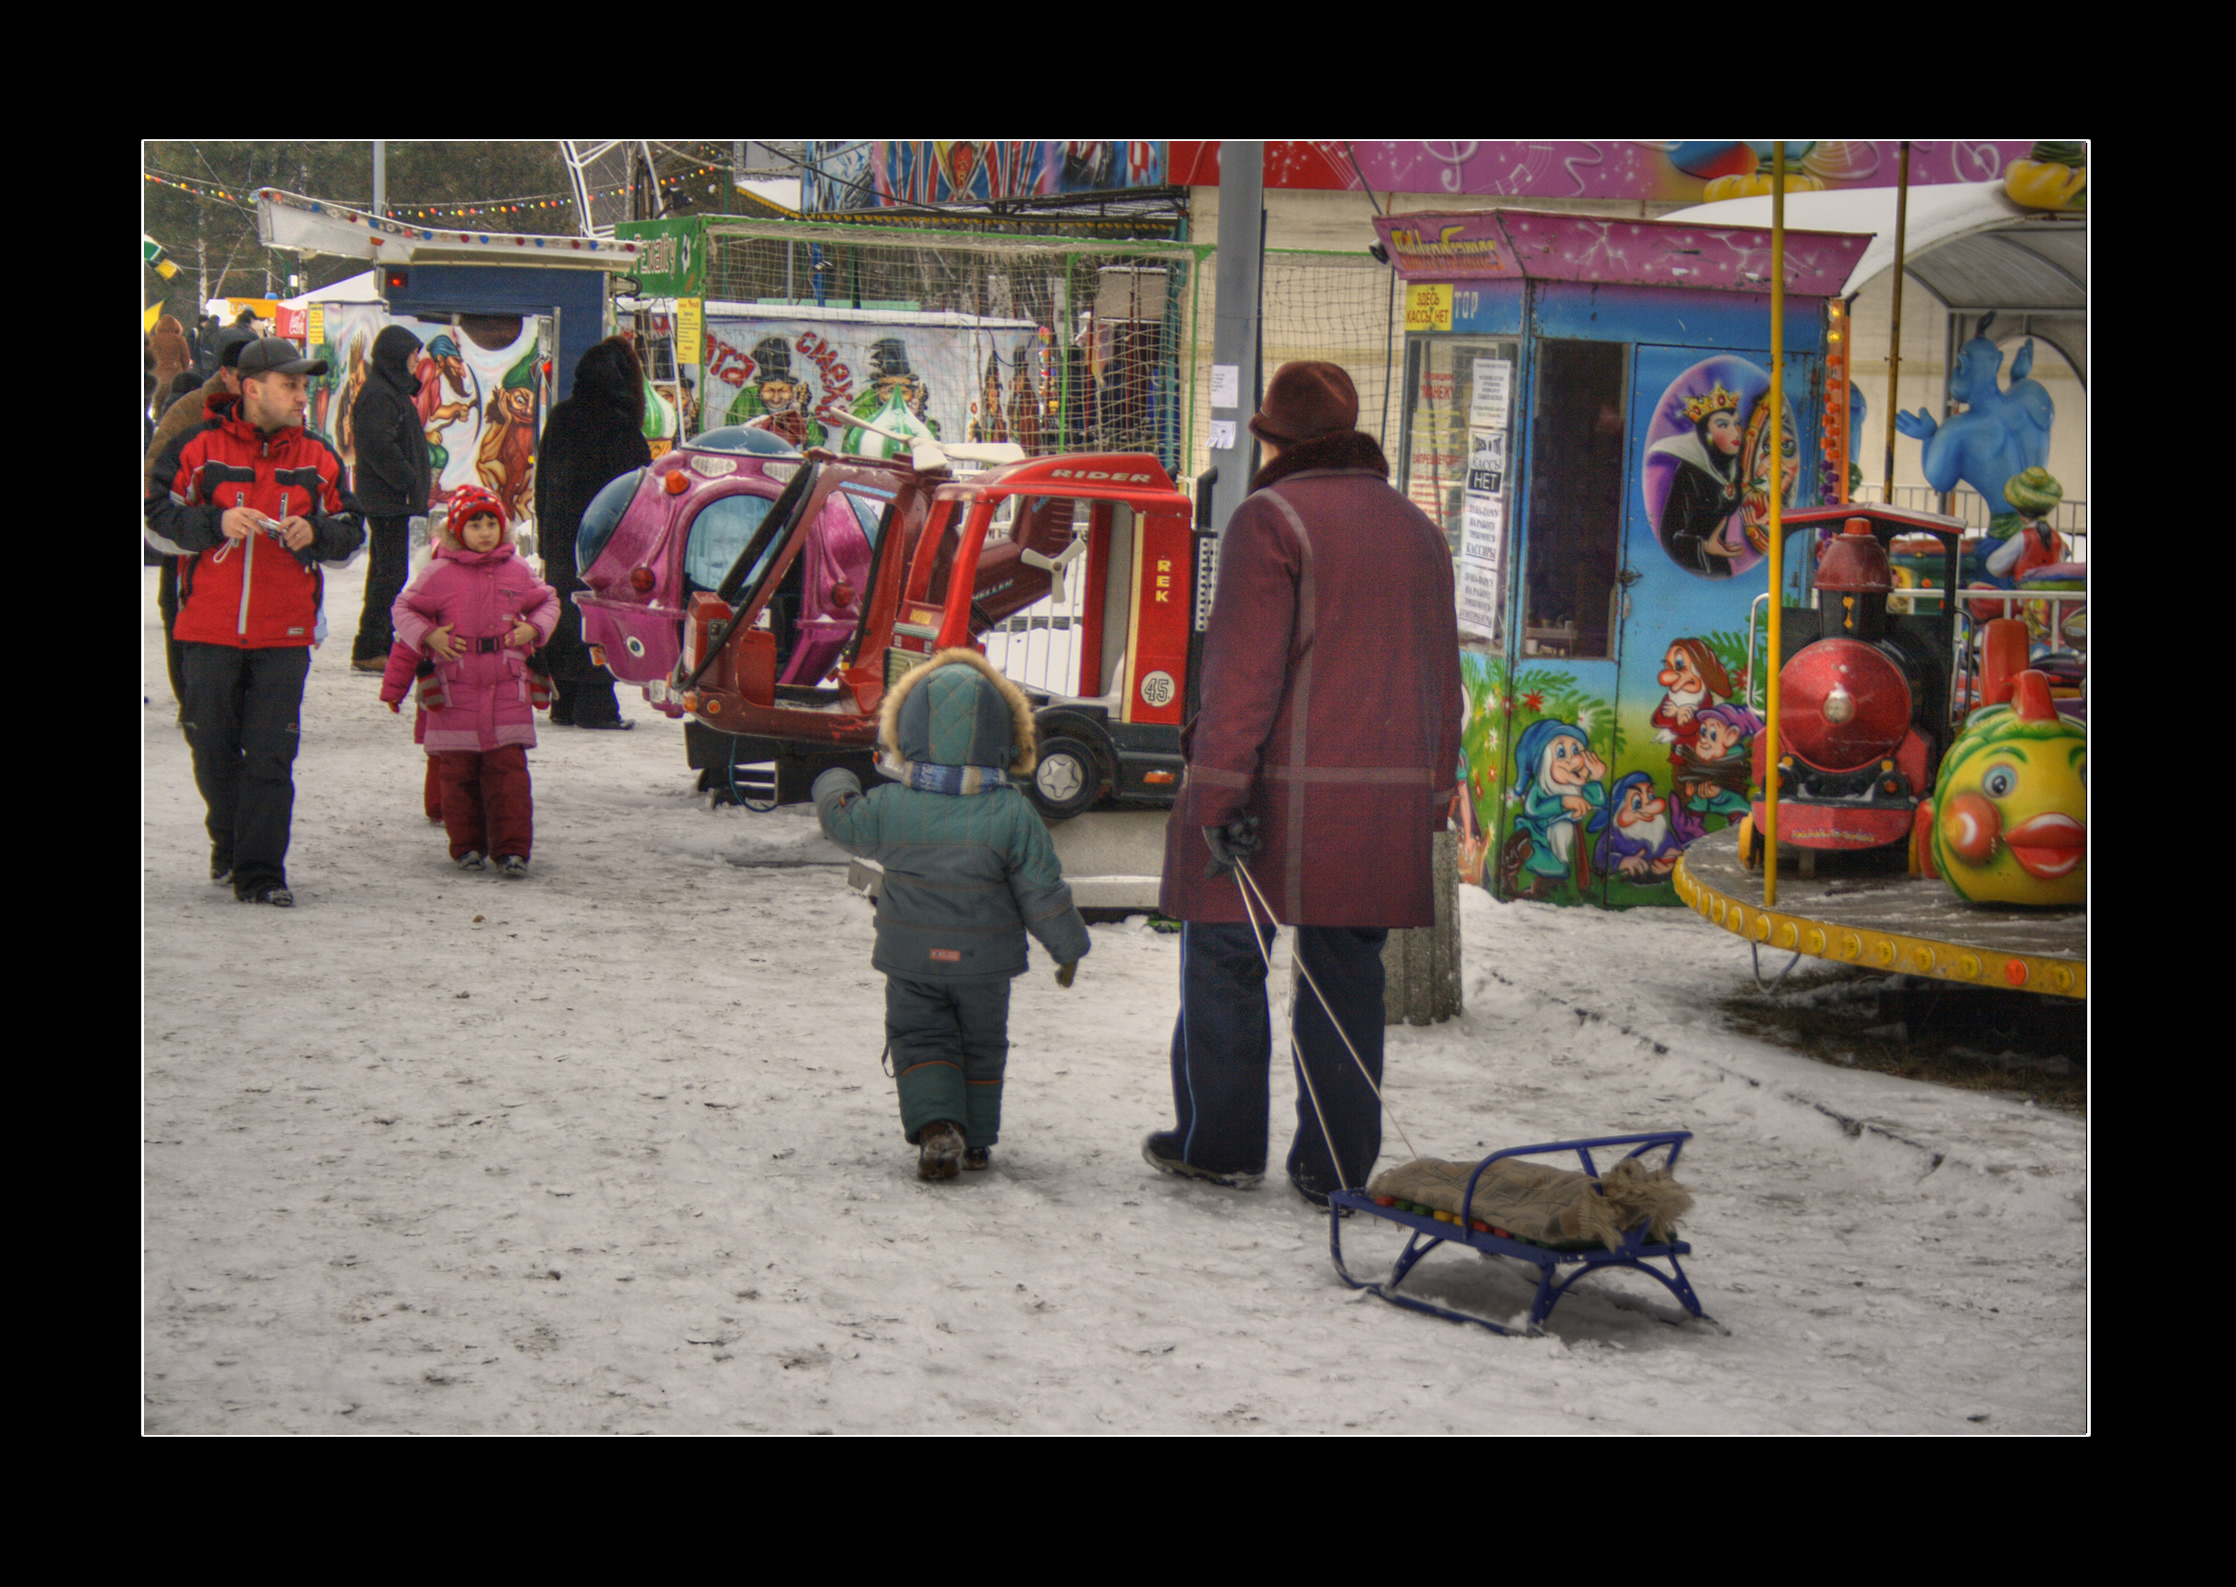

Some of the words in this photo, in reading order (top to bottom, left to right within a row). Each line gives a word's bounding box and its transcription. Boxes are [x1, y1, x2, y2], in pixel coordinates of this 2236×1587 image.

[1416, 291, 1440, 307] ЗДЕСЬ
[1406, 309, 1431, 323] КАССЫ
[1434, 309, 1449, 323] НЕТ
[1051, 469, 1151, 483] RIDER
[1473, 471, 1497, 490] НЕТ
[1155, 559, 1172, 602] REK
[1144, 678, 1169, 702] 45
